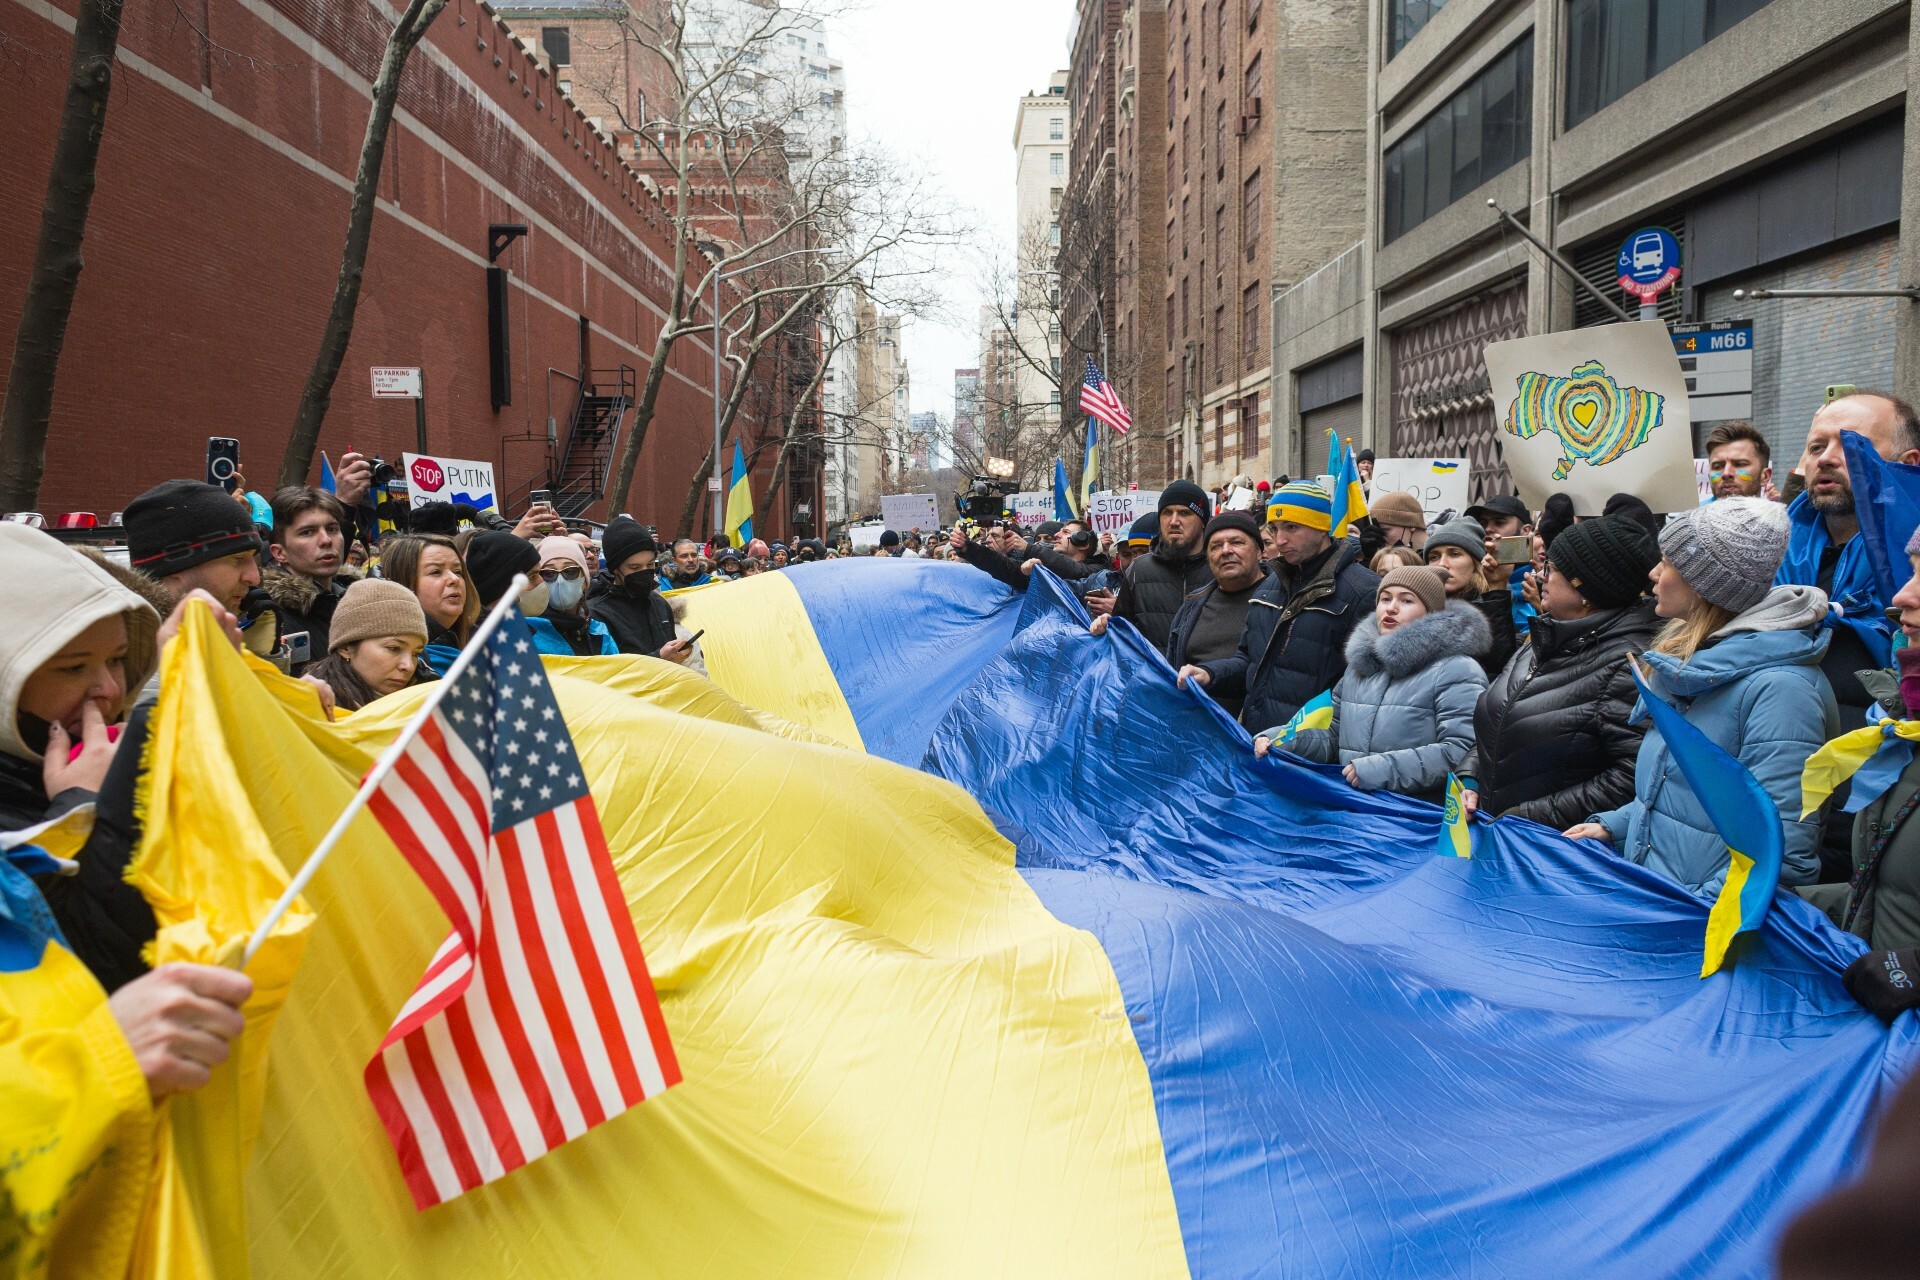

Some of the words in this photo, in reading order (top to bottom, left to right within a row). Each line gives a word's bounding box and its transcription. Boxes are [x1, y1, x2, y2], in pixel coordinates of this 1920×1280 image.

[1622, 279, 1635, 291] NO
[1635, 272, 1675, 293] STANDING
[1673, 325, 1700, 334] Minutes
[1711, 322, 1731, 330] Route
[1686, 337, 1697, 350] 4
[1711, 332, 1747, 349] M66
[414, 465, 442, 485] STOP
[447, 466, 491, 487] PUTIN
[1012, 497, 1034, 508] Fuck
[1039, 497, 1052, 508] off
[1097, 498, 1132, 512] STOP
[1016, 511, 1046, 523] Russia
[1095, 511, 1133, 531] PUTIN
